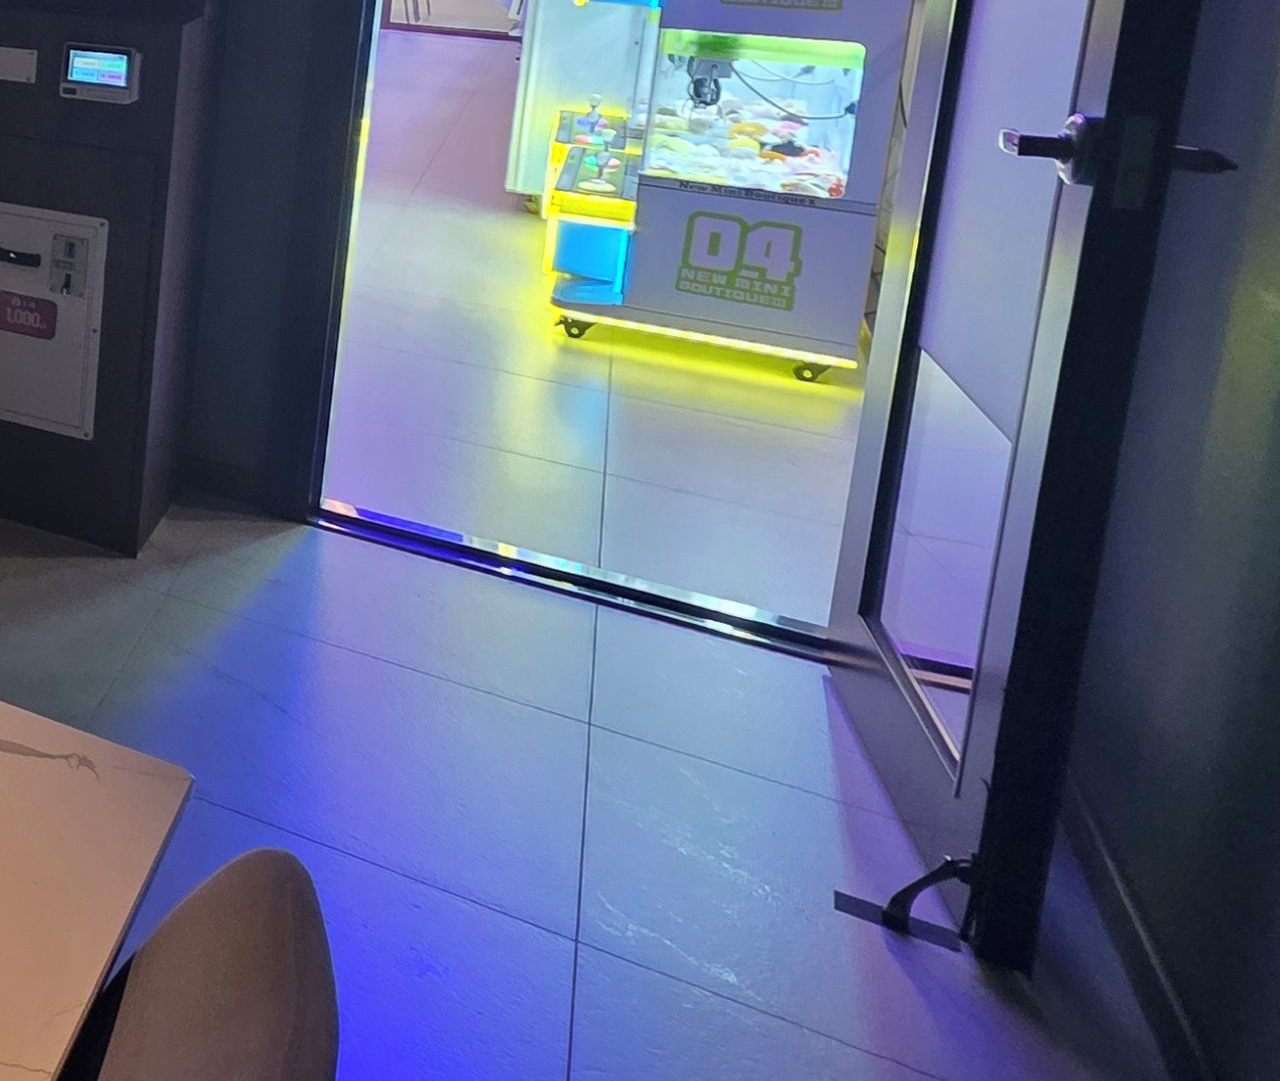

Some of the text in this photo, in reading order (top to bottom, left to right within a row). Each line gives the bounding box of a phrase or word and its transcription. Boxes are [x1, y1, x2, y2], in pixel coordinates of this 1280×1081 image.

[680, 181, 710, 192] New
[685, 212, 802, 282] 04
[681, 268, 792, 297] NEW MINI
